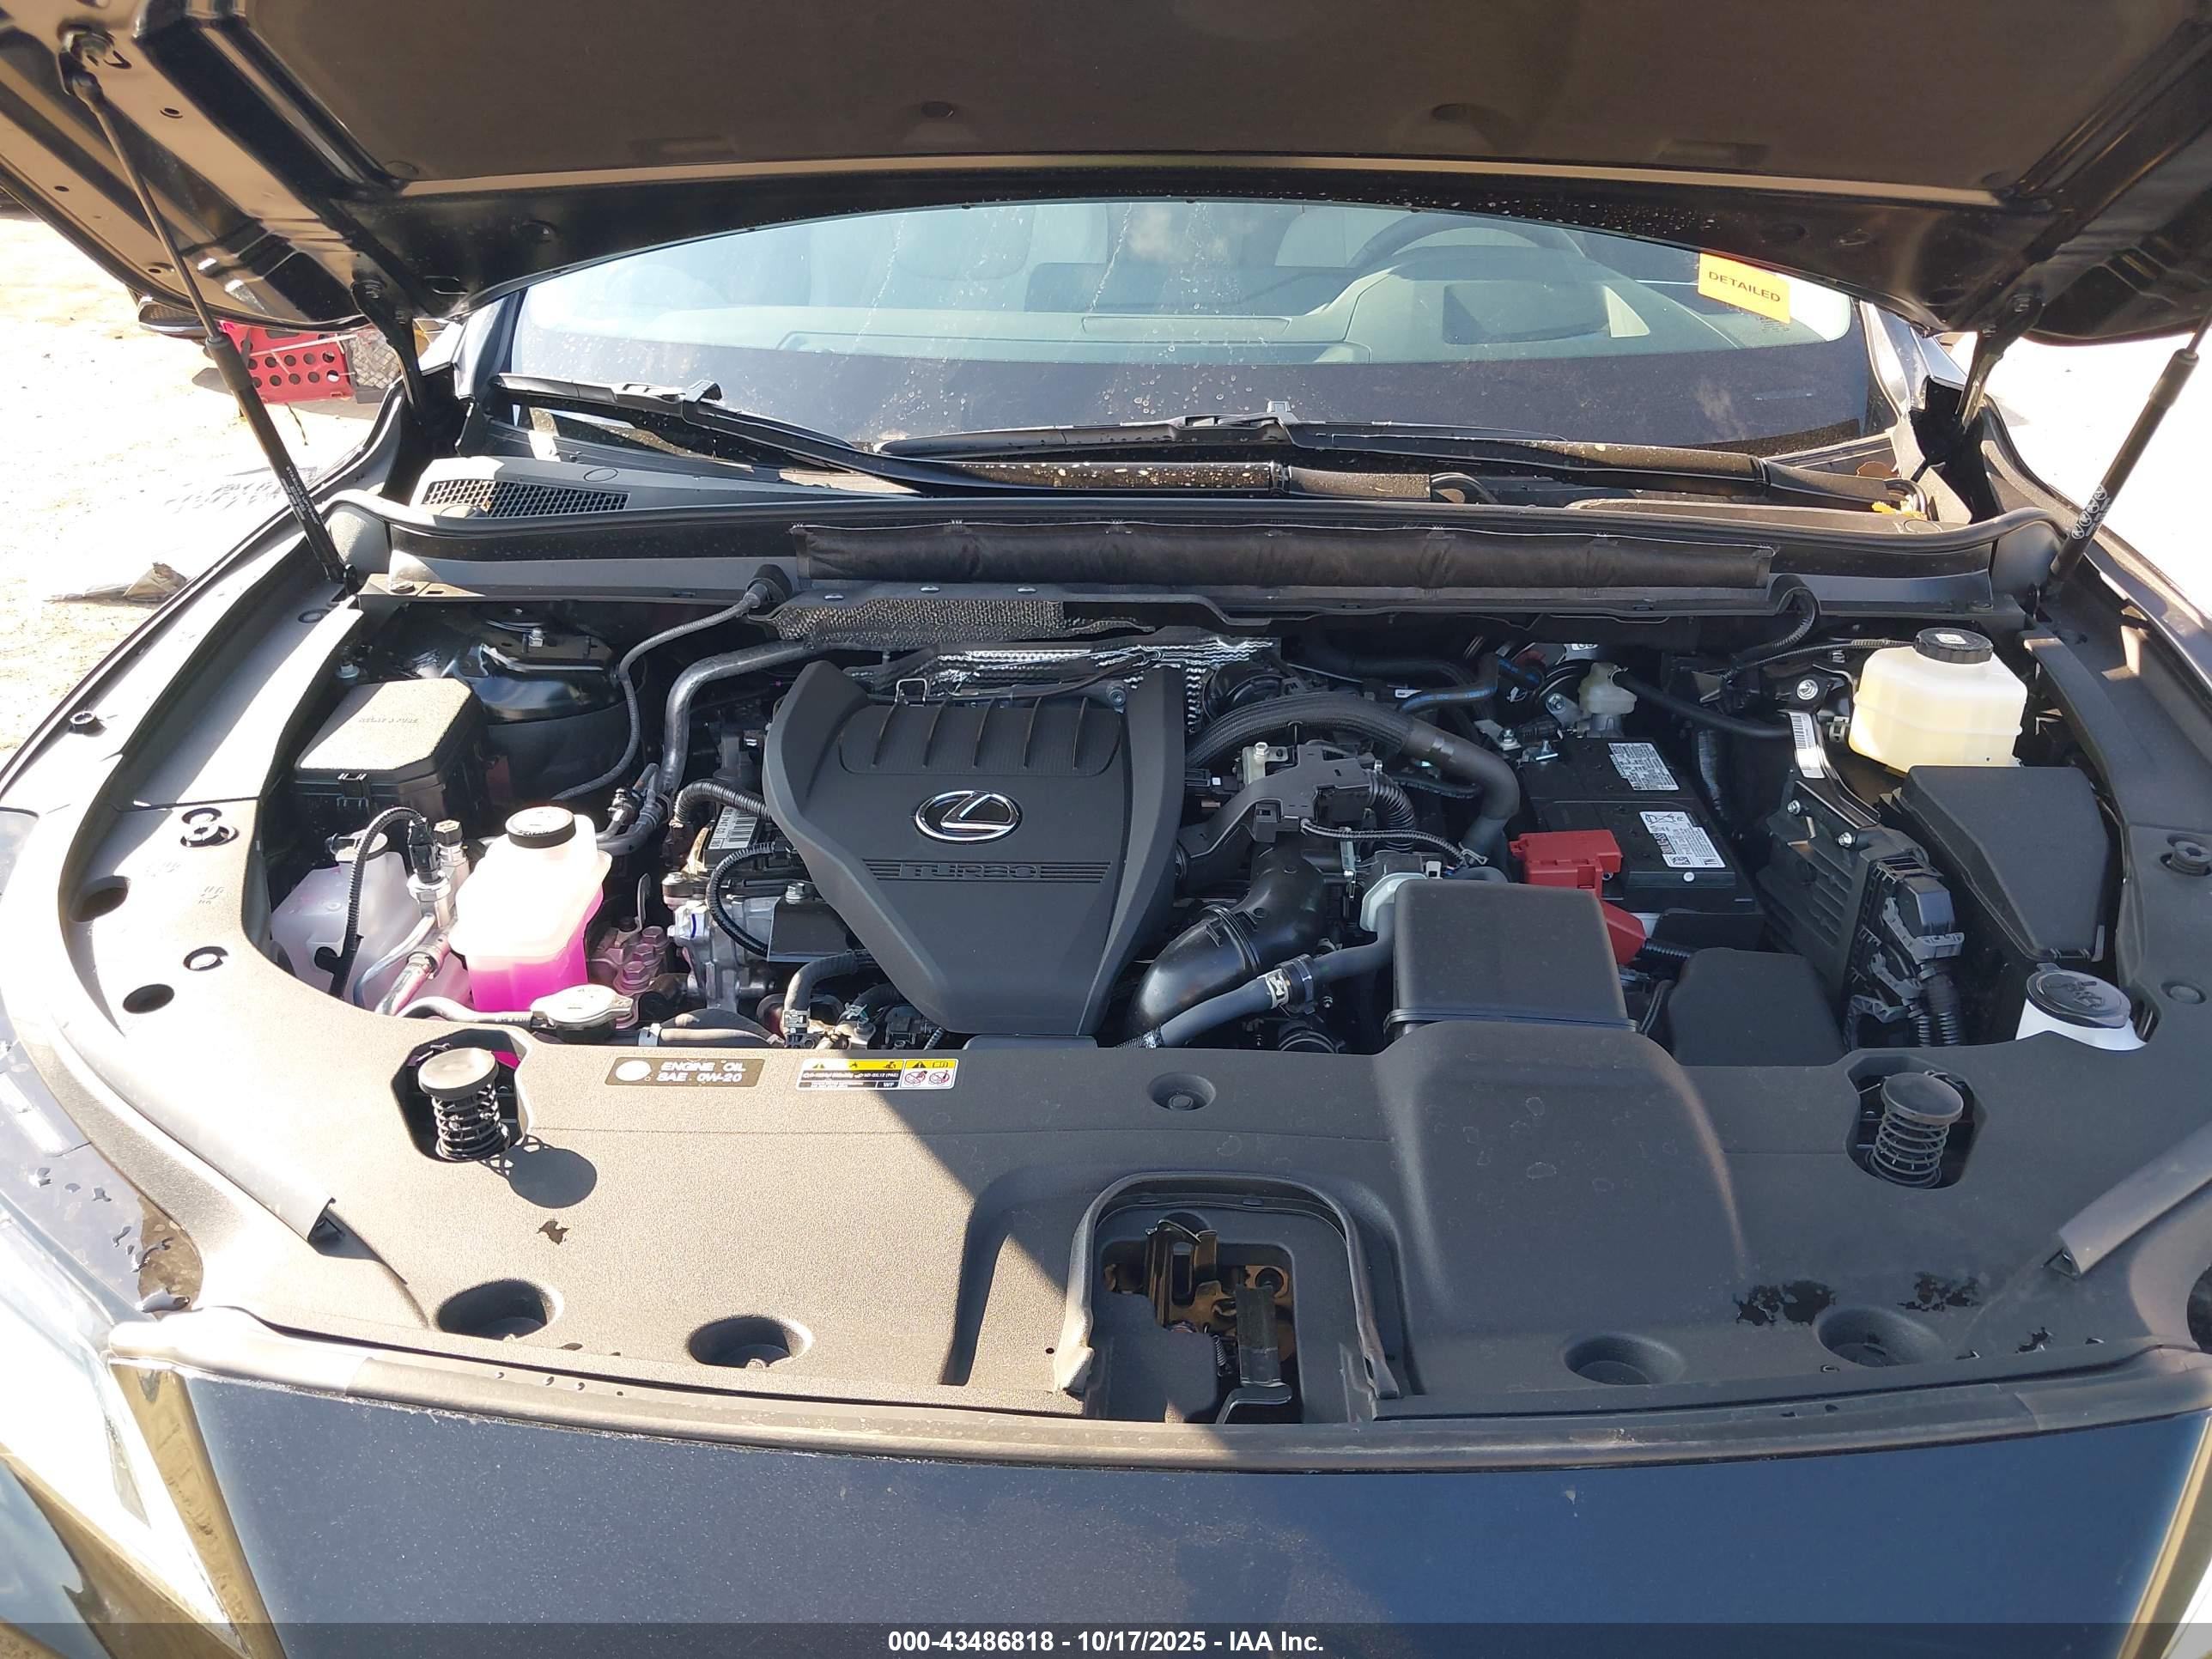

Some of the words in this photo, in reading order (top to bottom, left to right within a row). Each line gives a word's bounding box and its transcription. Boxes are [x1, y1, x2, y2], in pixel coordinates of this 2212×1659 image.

[1708, 270, 1782, 303] DETAILED
[902, 862, 1038, 878] TURBO
[659, 1060, 716, 1073] ENGINE
[722, 1061, 747, 1073] OIL
[656, 1073, 687, 1082] SAE
